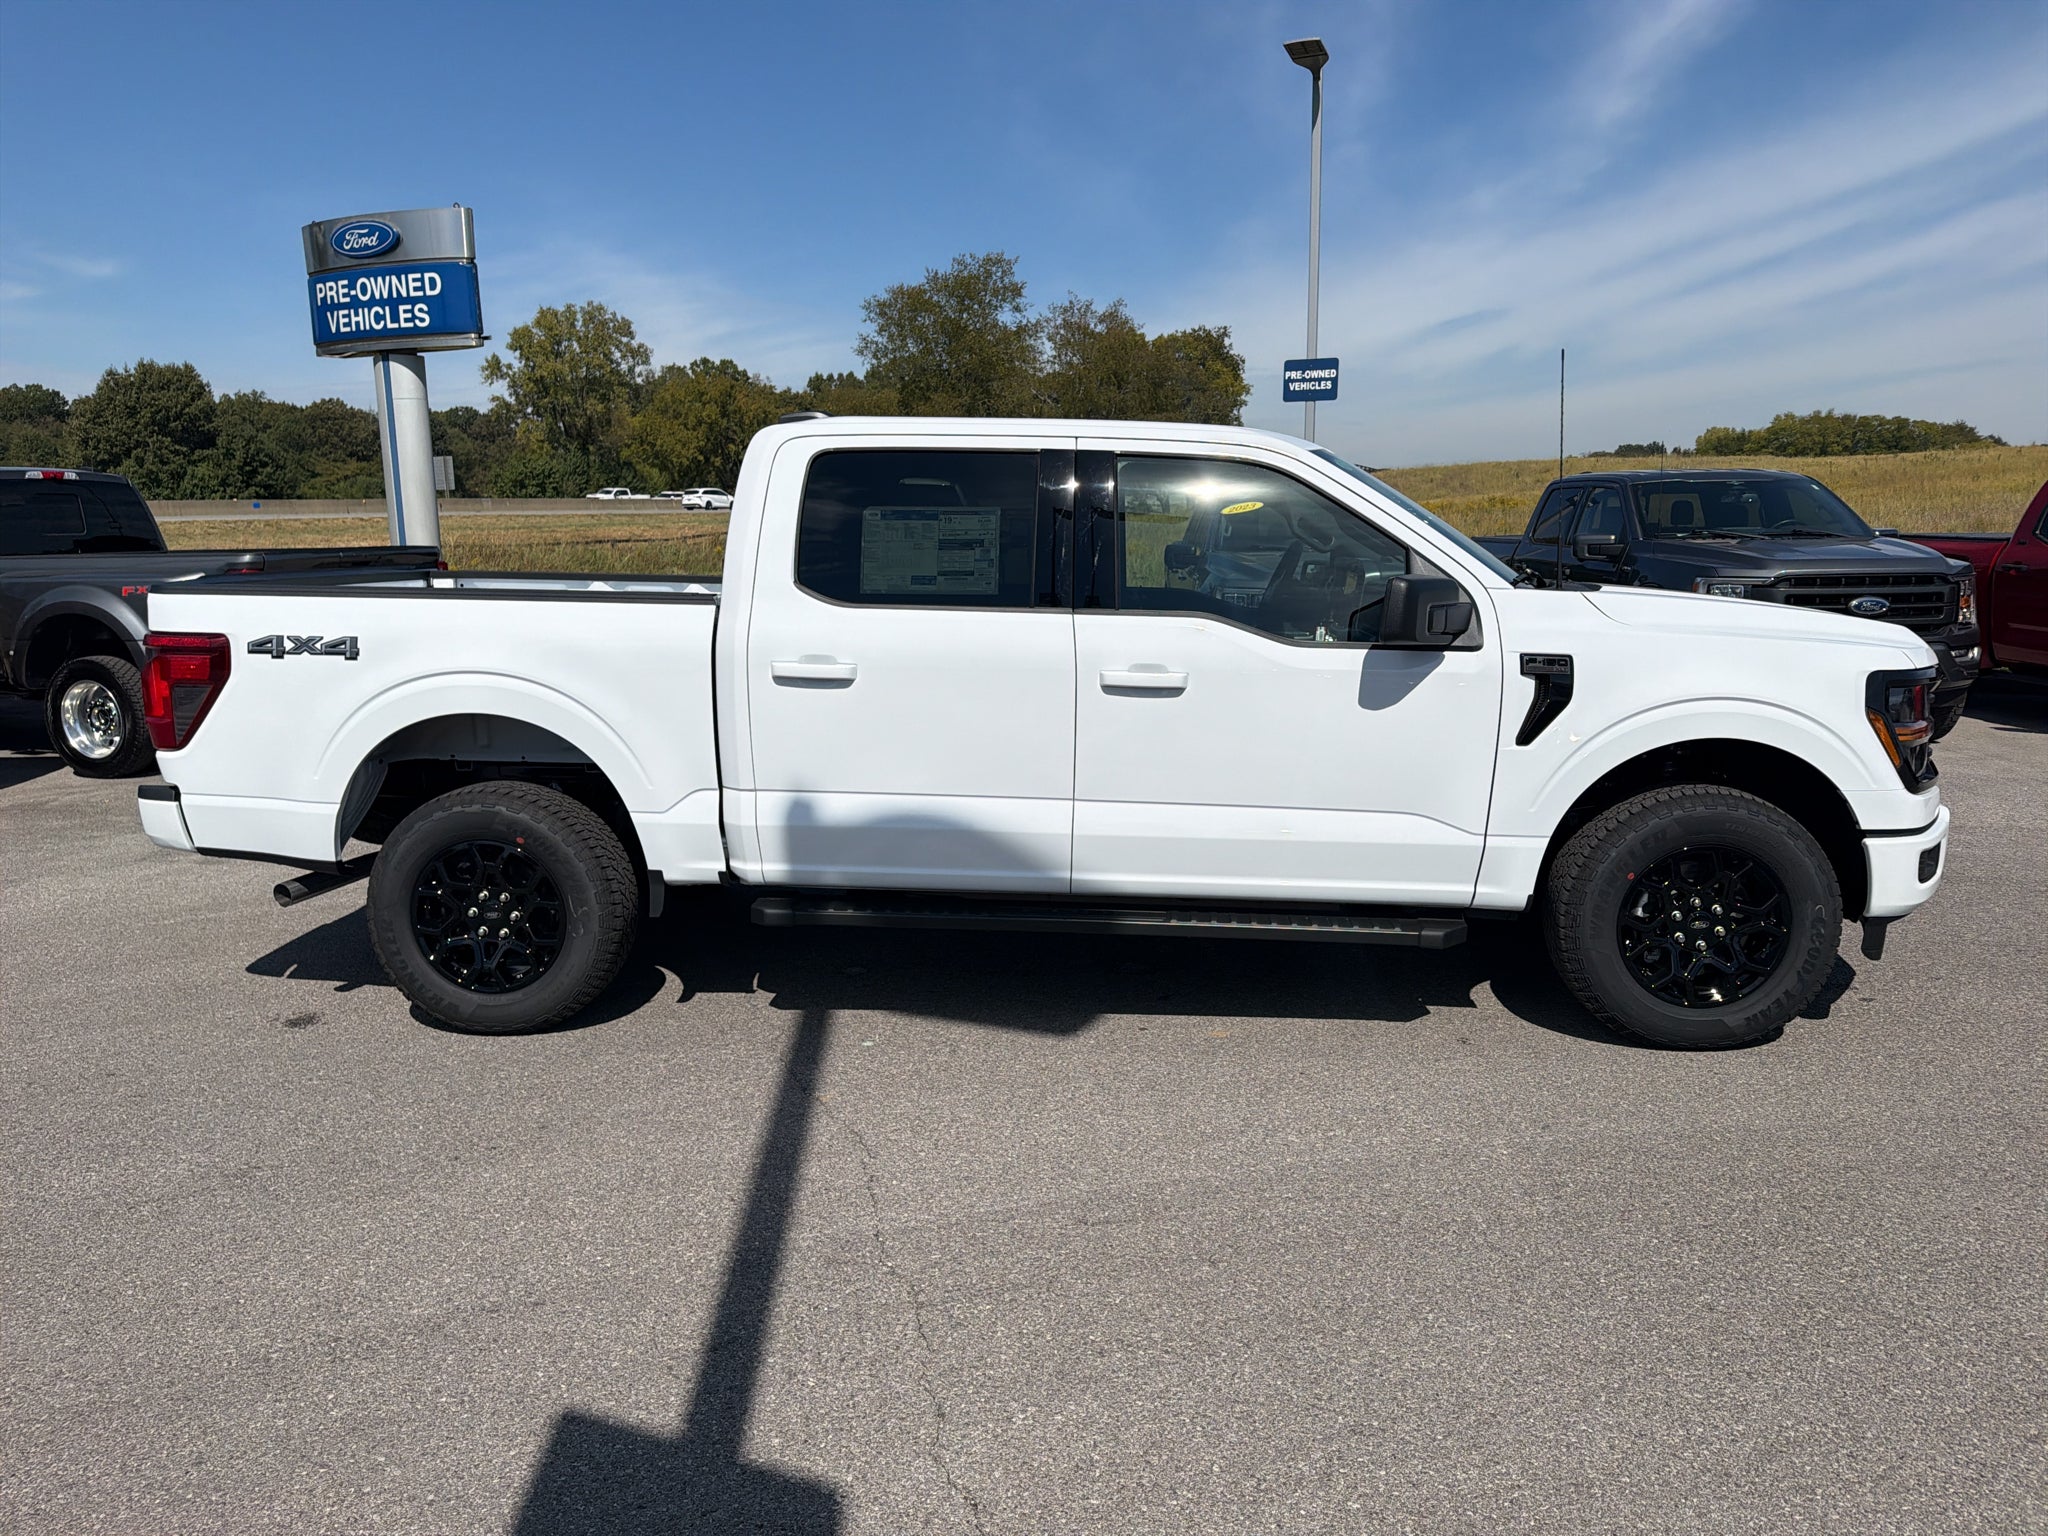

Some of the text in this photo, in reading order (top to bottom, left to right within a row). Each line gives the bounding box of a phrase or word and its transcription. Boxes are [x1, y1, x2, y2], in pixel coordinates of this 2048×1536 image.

[343, 228, 379, 250] Ford
[316, 272, 442, 306] PRE-OWNED
[327, 303, 430, 333] VEHICLES
[1285, 369, 1337, 380] PRE-OWNED
[1289, 381, 1332, 391] VEHICLES
[122, 585, 150, 597] FX
[1525, 657, 1569, 667] F-150
